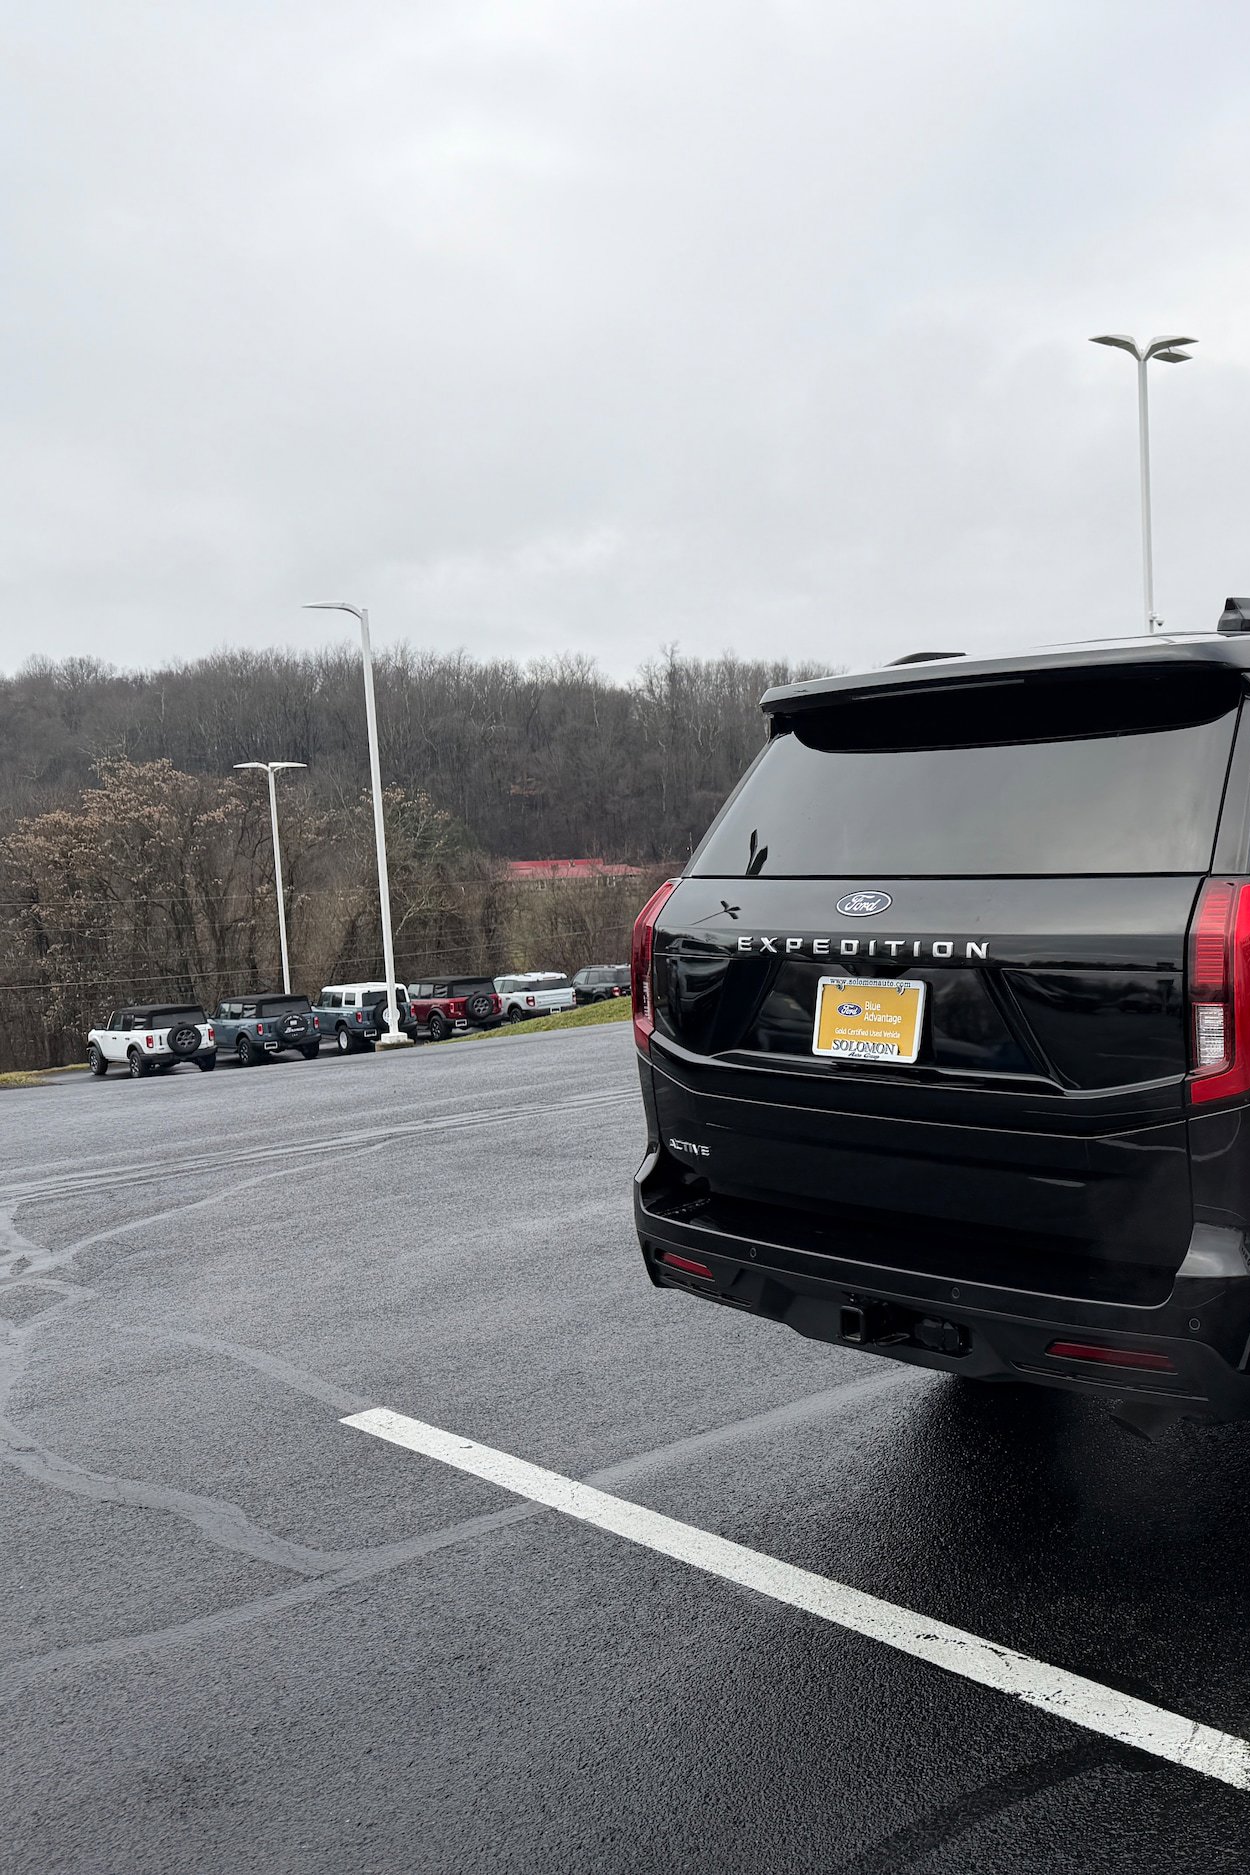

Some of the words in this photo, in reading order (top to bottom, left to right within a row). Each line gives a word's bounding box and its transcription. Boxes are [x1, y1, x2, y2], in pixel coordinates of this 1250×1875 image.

[842, 895, 883, 914] Ford
[737, 936, 990, 961] EXPEDITION
[829, 977, 912, 988] www.solomonauto.com
[838, 1004, 861, 1016] Ford
[864, 1000, 881, 1011] Blue
[863, 1013, 903, 1025] Advantage
[835, 1027, 847, 1035] Gold
[847, 1028, 869, 1037] Certified
[869, 1029, 883, 1037] Used
[883, 1030, 901, 1039] Vehicle
[832, 1039, 896, 1055] SOLOMON
[669, 1138, 712, 1157] ACTIVE
